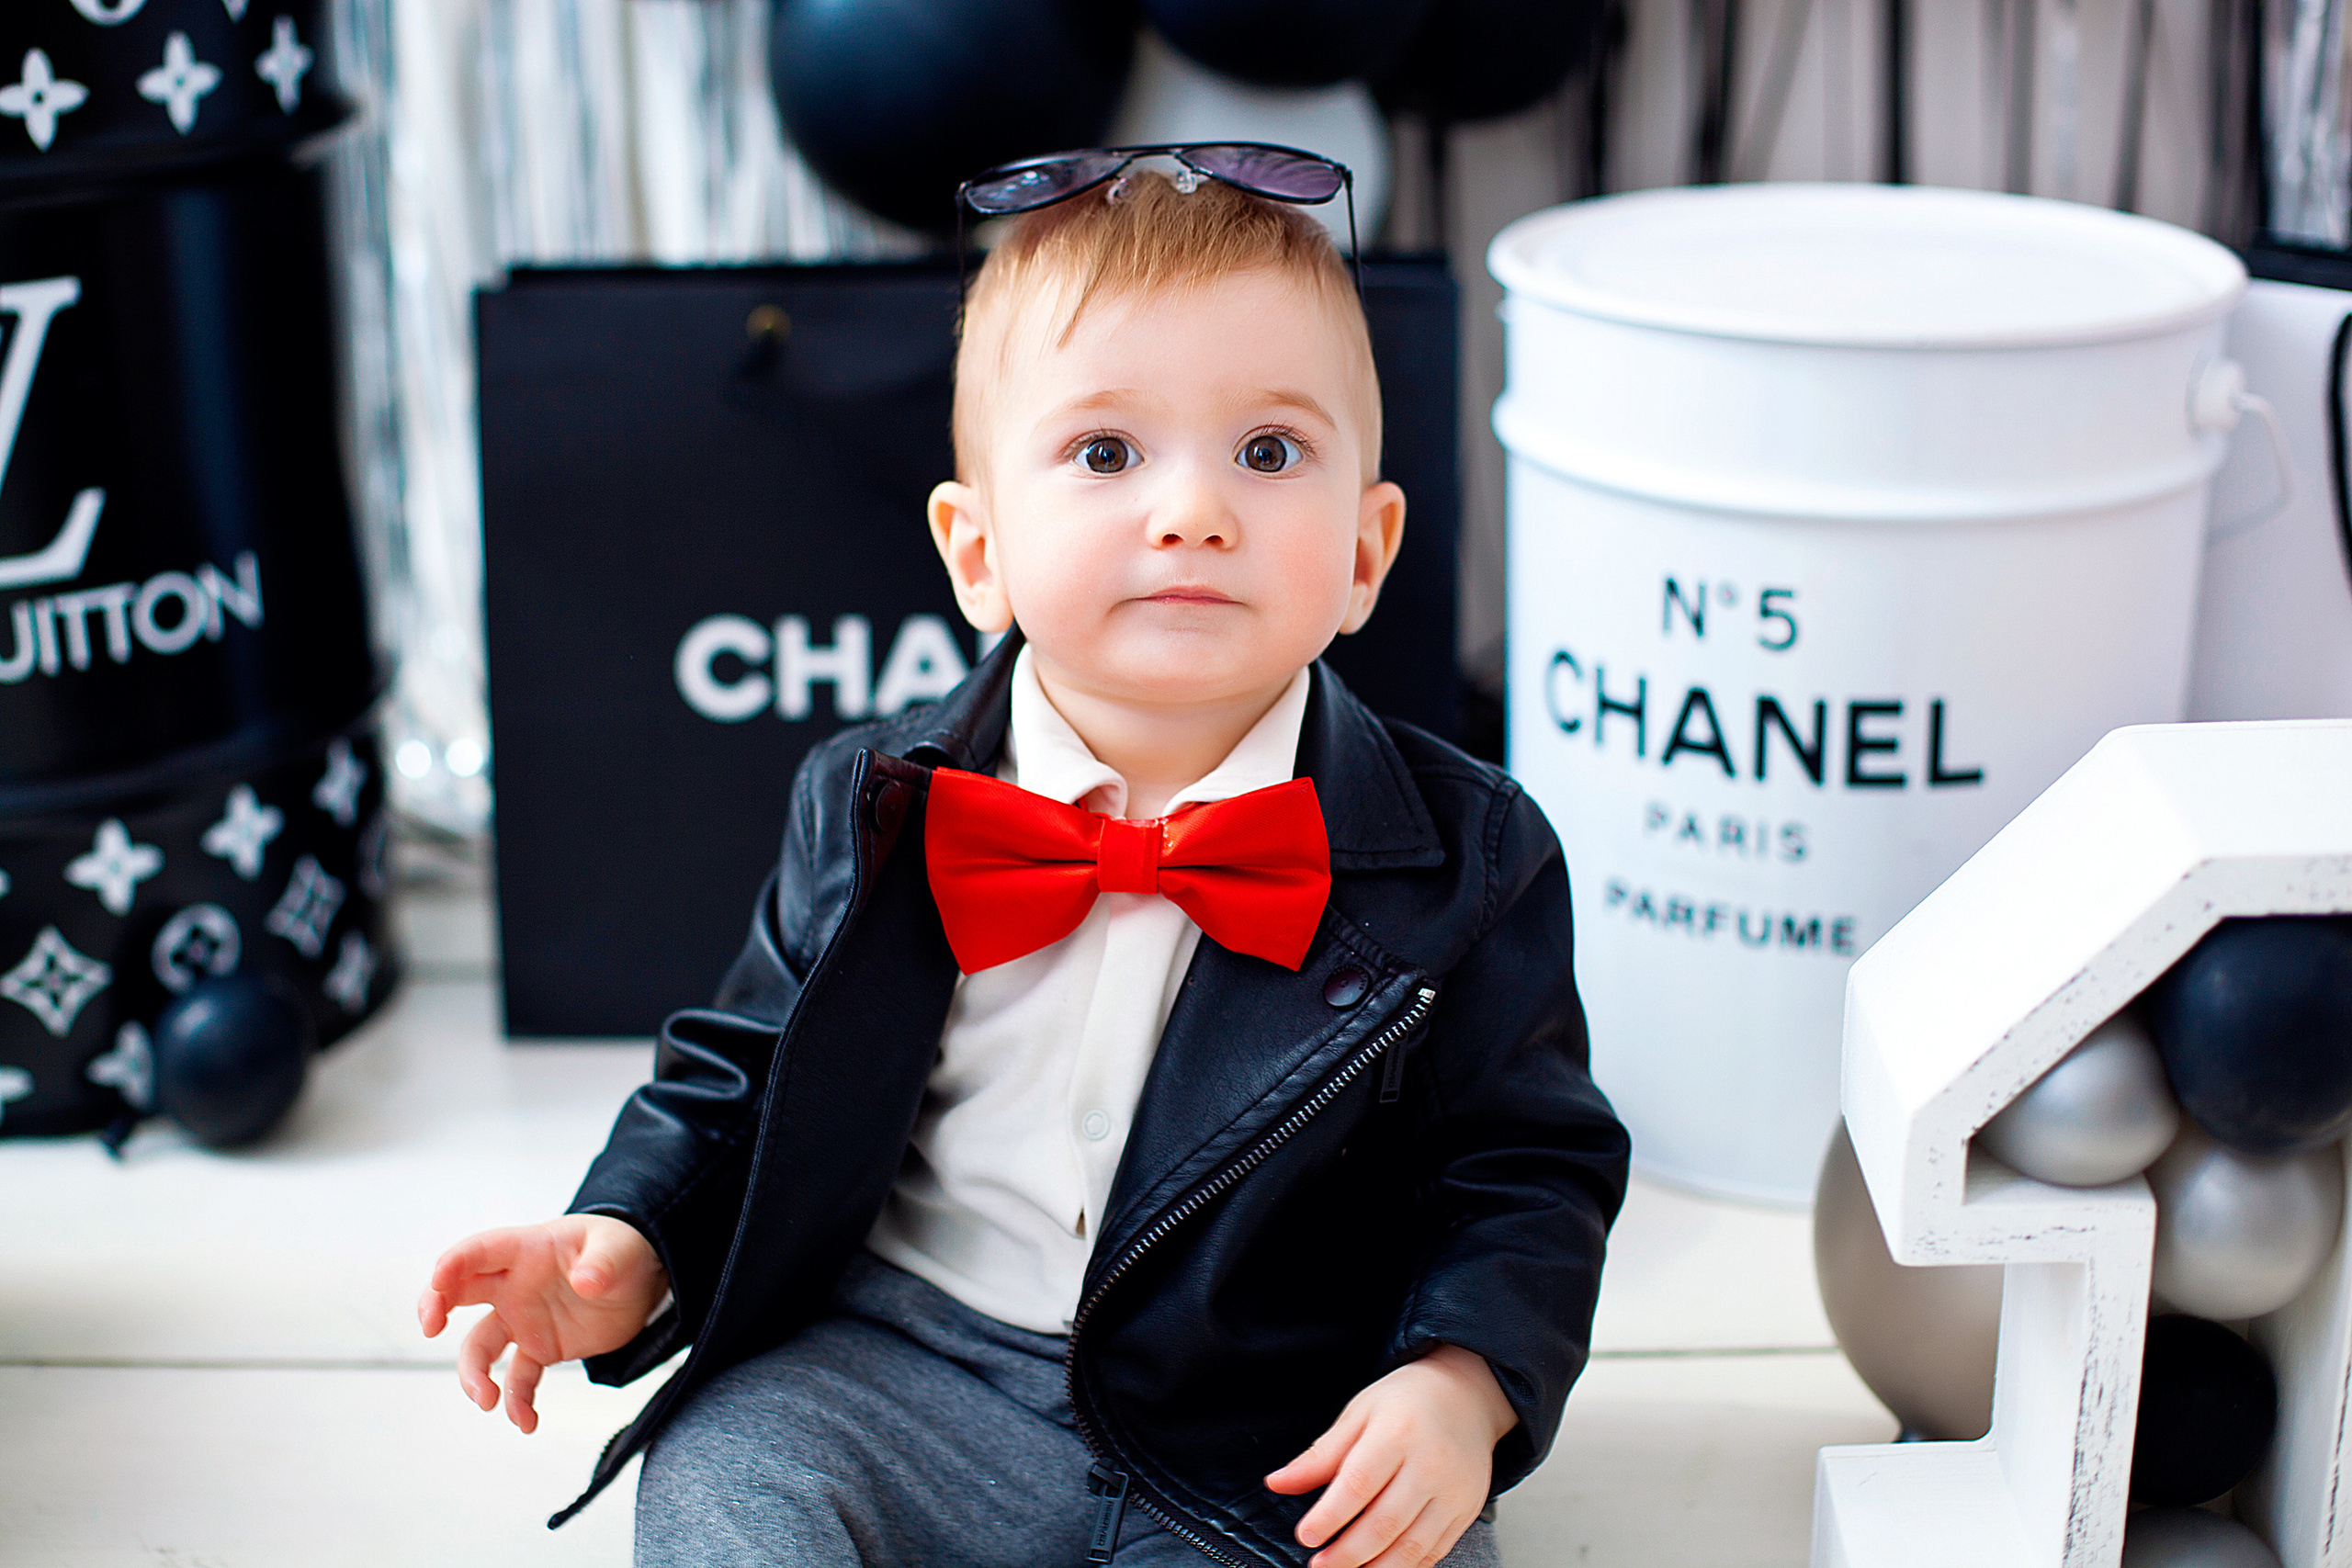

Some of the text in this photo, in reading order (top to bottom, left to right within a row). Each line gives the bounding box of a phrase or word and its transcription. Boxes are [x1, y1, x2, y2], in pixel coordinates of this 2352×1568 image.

[673, 614, 1009, 724] CHA
[1544, 648, 1984, 788] CHANEL
[1646, 801, 1810, 863] PARIS
[1604, 876, 1858, 957] PARFUME
